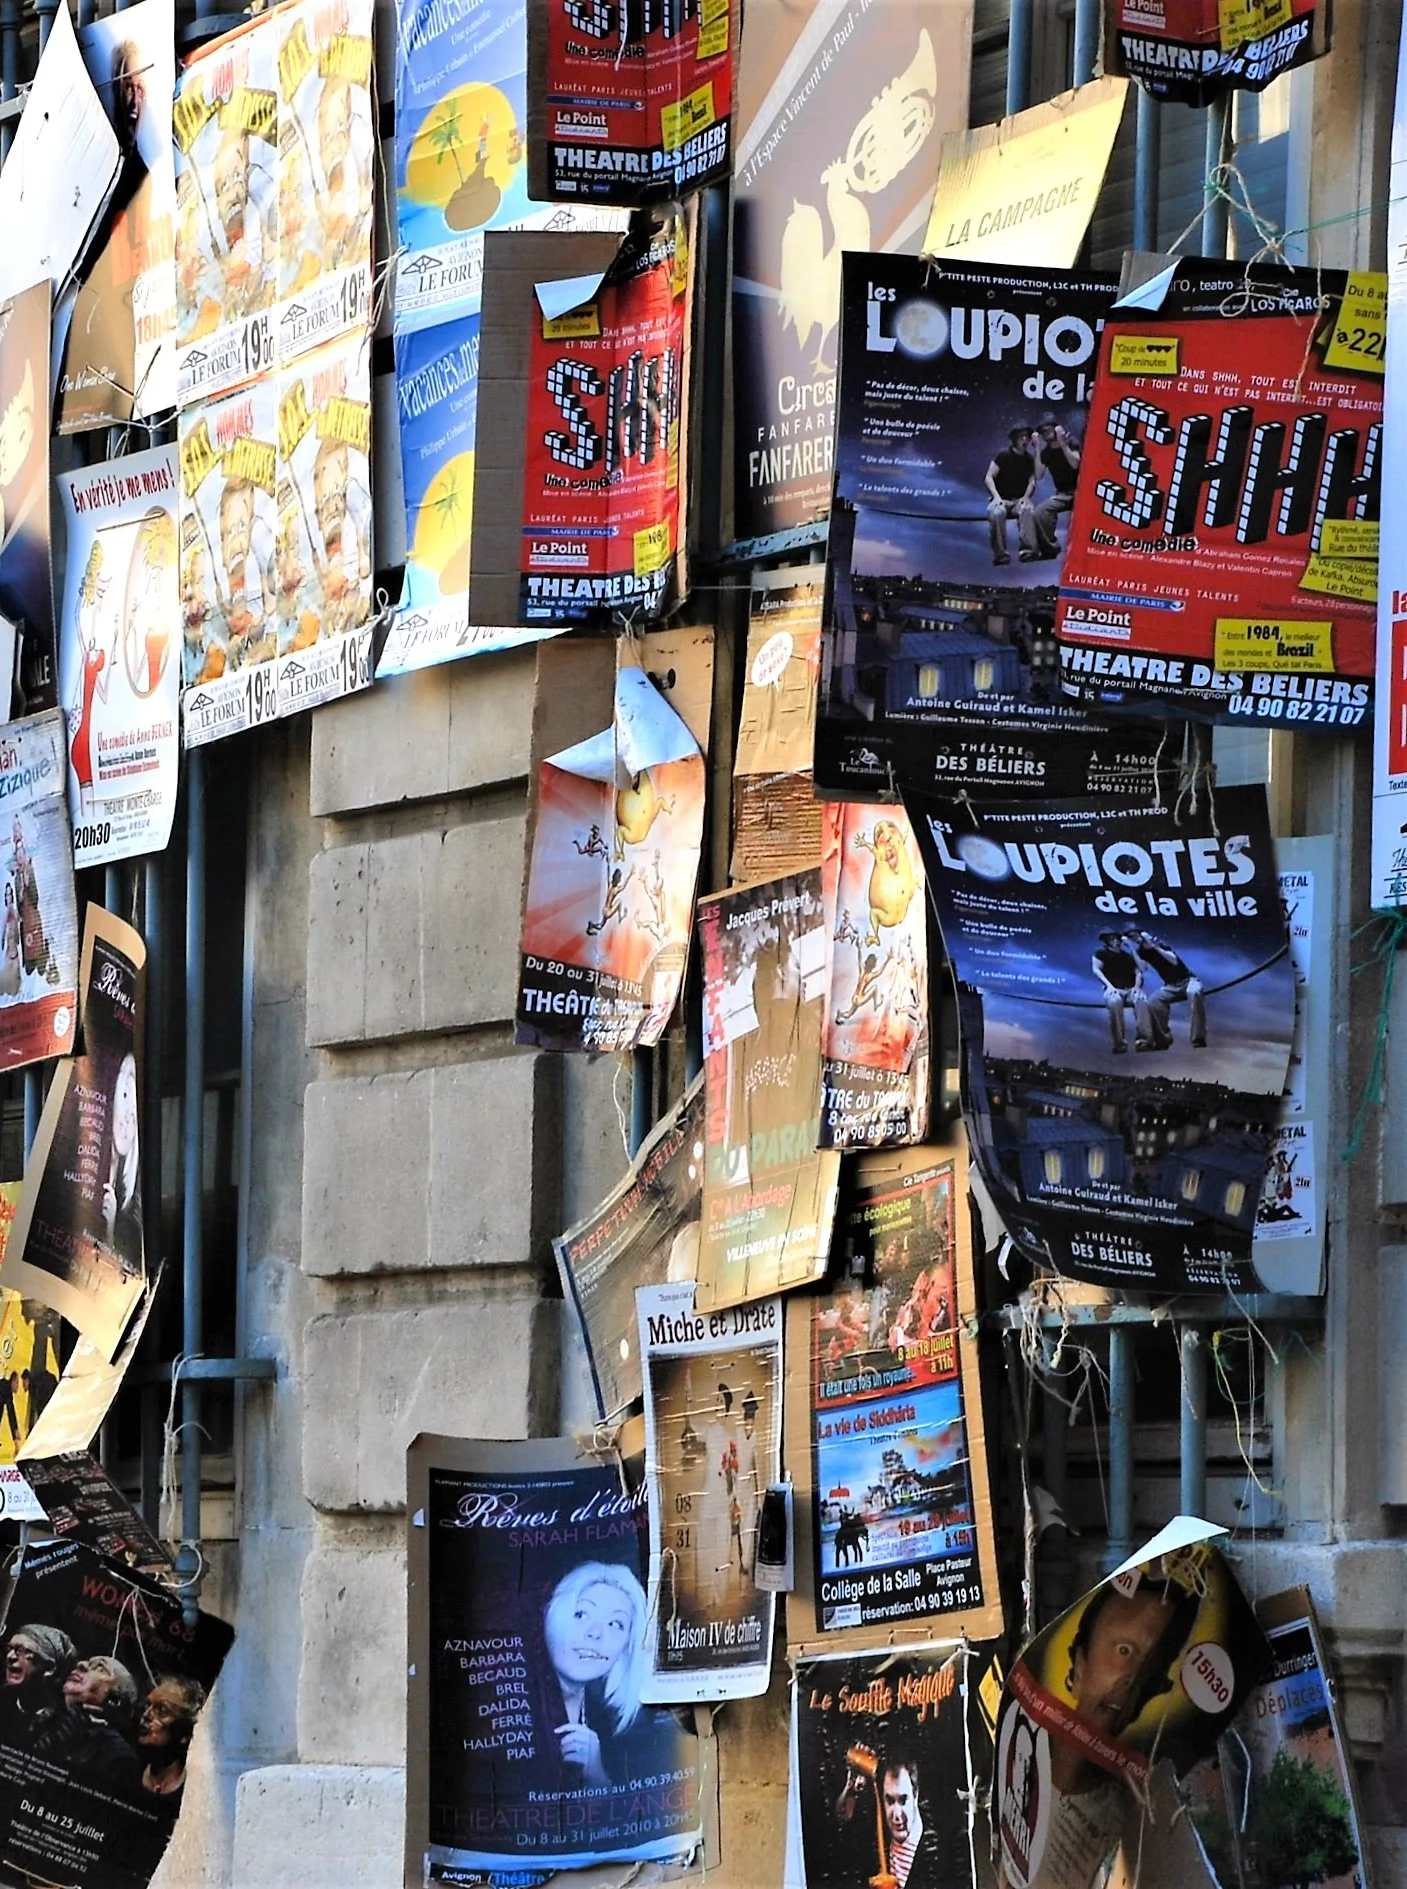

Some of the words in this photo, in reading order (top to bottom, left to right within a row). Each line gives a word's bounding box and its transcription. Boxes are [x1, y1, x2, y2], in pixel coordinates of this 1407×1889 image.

[557, 111, 571, 122] Le
[573, 111, 606, 125] Point
[684, 122, 727, 161] BELIERS
[976, 179, 1083, 239] CAMPAGNE
[867, 282, 896, 301] les
[306, 302, 340, 332] FORUM
[206, 348, 241, 376] FORUM
[1133, 356, 1167, 368] minutes
[1022, 371, 1065, 400] de
[1151, 378, 1172, 391] TOUT
[1250, 375, 1276, 388] TOUT
[1308, 381, 1357, 395] INTERDIT
[70, 483, 86, 513] En
[85, 474, 115, 510] vérité
[126, 476, 141, 500] me
[141, 468, 168, 494] mens
[532, 542, 548, 554] Le
[551, 542, 587, 554] Point
[1090, 528, 1117, 546] Une
[1120, 532, 1199, 554] comédie
[527, 577, 621, 598] THEATRE
[1117, 579, 1147, 592] PARIS
[1153, 584, 1190, 597] JEUNES
[1197, 589, 1240, 602] TALENTS
[1066, 605, 1087, 622] Le
[1089, 608, 1131, 627] Point
[1276, 642, 1314, 658] Brazil
[305, 664, 340, 692] FORUM
[1059, 645, 1184, 683] THEATRE
[1191, 664, 1245, 693] DES
[1252, 672, 1369, 707] BELIERS
[1103, 678, 1136, 691] portail
[213, 698, 246, 725] FORUM
[905, 696, 951, 709] Antoine
[954, 700, 1000, 713] Guiraud
[1018, 703, 1049, 717] Kamel
[1228, 695, 1253, 716] 04
[1256, 697, 1283, 718] 90
[1285, 700, 1311, 720] 82
[1339, 705, 1366, 725] 07
[936, 755, 968, 771] DES
[975, 755, 1045, 776] BÉLIERS
[75, 822, 110, 849] 20h30
[931, 828, 1255, 888] LOUPIOTES
[726, 904, 770, 931] Jacques
[771, 889, 811, 915] Prévert
[1094, 890, 1138, 914] de
[1147, 891, 1178, 916] la
[1186, 889, 1258, 917] ville
[526, 956, 544, 971] Du
[546, 960, 564, 975] 20
[1074, 1187, 1111, 1201] Guiraud
[864, 1198, 911, 1222] écologique
[1071, 1242, 1094, 1258] DES
[1099, 1244, 1153, 1267] BÉLIERS
[646, 1311, 705, 1347] Miche
[732, 1303, 777, 1334] Drate
[818, 1418, 834, 1439] La
[835, 1416, 851, 1436] vie
[852, 1413, 867, 1432] de
[508, 1529, 578, 1549] SARAH
[52, 1544, 79, 1560] rouges
[35, 1555, 78, 1580] présentent
[926, 1562, 945, 1574] Place
[946, 1557, 972, 1570] Pasteur
[821, 1577, 864, 1603] Collège
[868, 1575, 880, 1594] de
[883, 1572, 893, 1590] la
[895, 1568, 921, 1589] Salle
[936, 1572, 965, 1587] Avignon
[862, 1602, 914, 1620] réservation:
[914, 1596, 926, 1611] 04
[929, 1593, 940, 1609] 90
[942, 1592, 954, 1607] 39
[956, 1589, 967, 1603] 19
[969, 1586, 980, 1602] 13
[443, 1635, 524, 1652] AZNAVOUR
[667, 1620, 707, 1650] Maison
[460, 1652, 526, 1670] BARBARA
[468, 1667, 527, 1685] BECAUD
[1189, 1652, 1231, 1706] 15h30
[496, 1681, 529, 1696] BREL
[810, 1688, 833, 1710] Le
[839, 1676, 893, 1712] Souffle
[478, 1699, 530, 1718] DALIDA
[491, 1713, 533, 1729] FERRÉ
[463, 1731, 534, 1751] HALLYDAY
[506, 1746, 536, 1761] PIAF
[528, 1788, 609, 1803] Réservations
[20, 1800, 34, 1813] Du
[36, 1807, 44, 1817] 8
[45, 1812, 58, 1823] au
[60, 1816, 73, 1829] 25
[74, 1822, 105, 1842] juillet
[441, 1870, 483, 1883] Avignon
